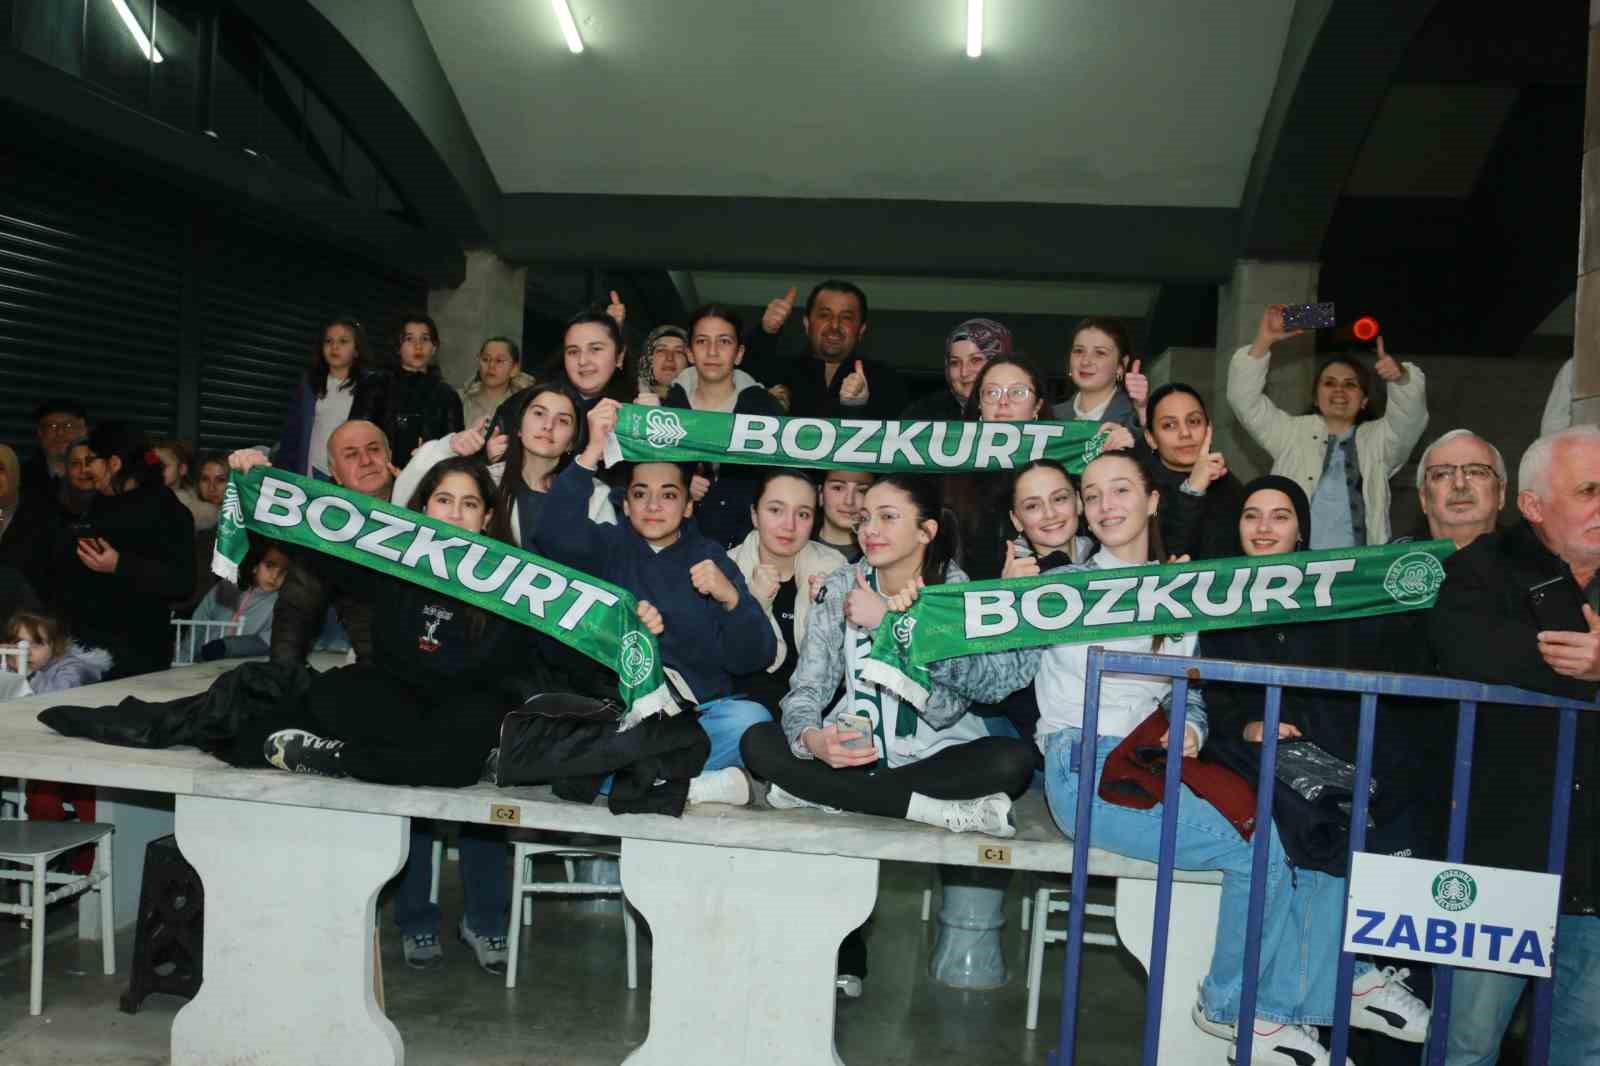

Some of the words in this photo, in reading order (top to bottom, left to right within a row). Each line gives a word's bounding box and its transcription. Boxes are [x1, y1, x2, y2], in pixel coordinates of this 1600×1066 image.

[726, 413, 1064, 469] BOZKURT
[253, 476, 620, 631] BOZKURT
[963, 558, 1356, 639] BOZKURT
[496, 808, 515, 820] C-2
[984, 848, 1004, 861] C-1
[1351, 908, 1546, 968] ZABITA
